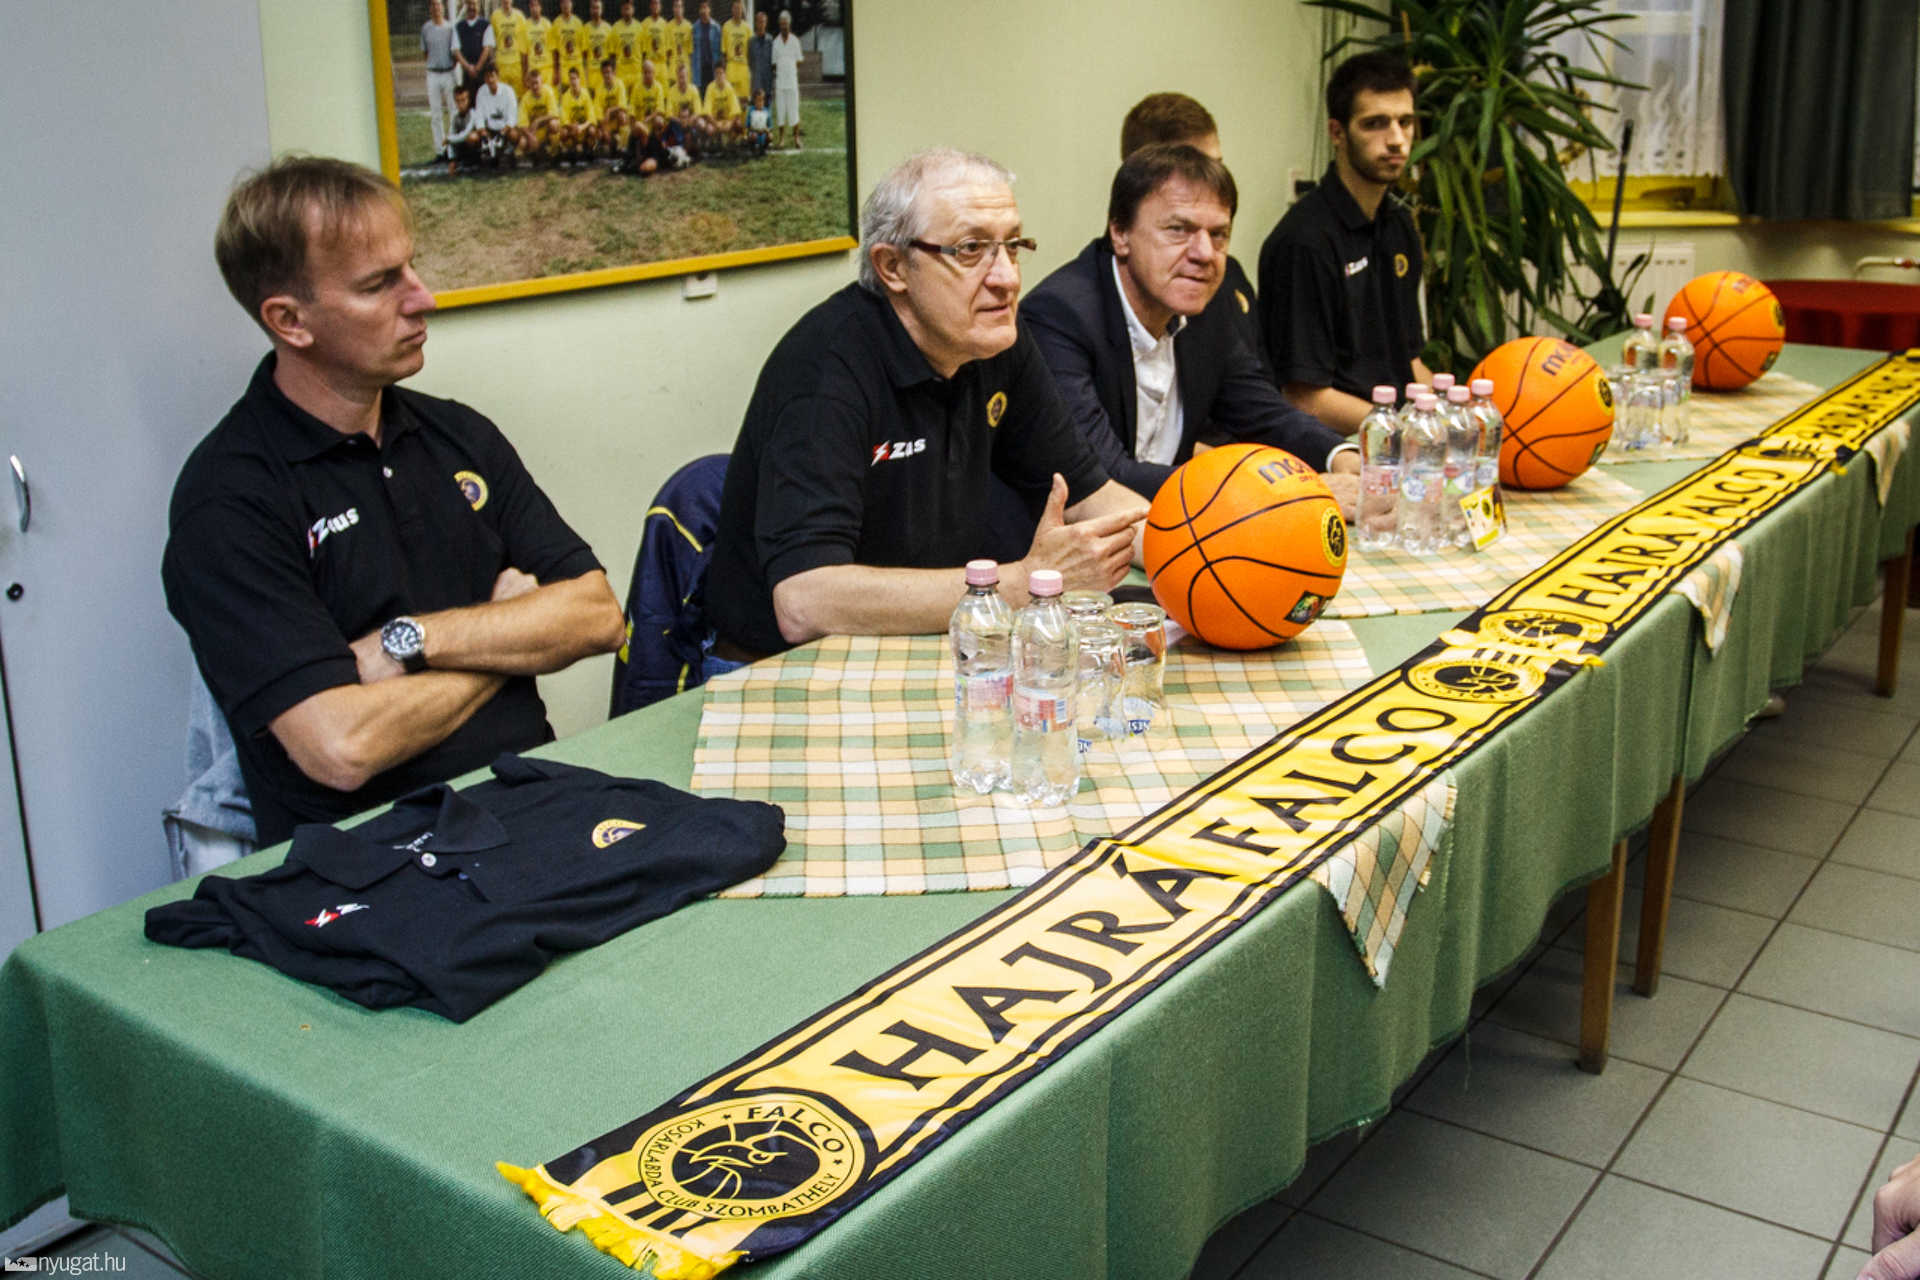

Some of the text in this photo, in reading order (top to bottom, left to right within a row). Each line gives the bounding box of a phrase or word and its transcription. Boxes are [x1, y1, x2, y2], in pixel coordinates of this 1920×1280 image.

[833, 706, 1458, 1091] HAJRÁ FALCO
[747, 1105, 845, 1153] FALCO
[656, 1189, 701, 1209] CLUB
[703, 1173, 841, 1217] SZOMBATHELY
